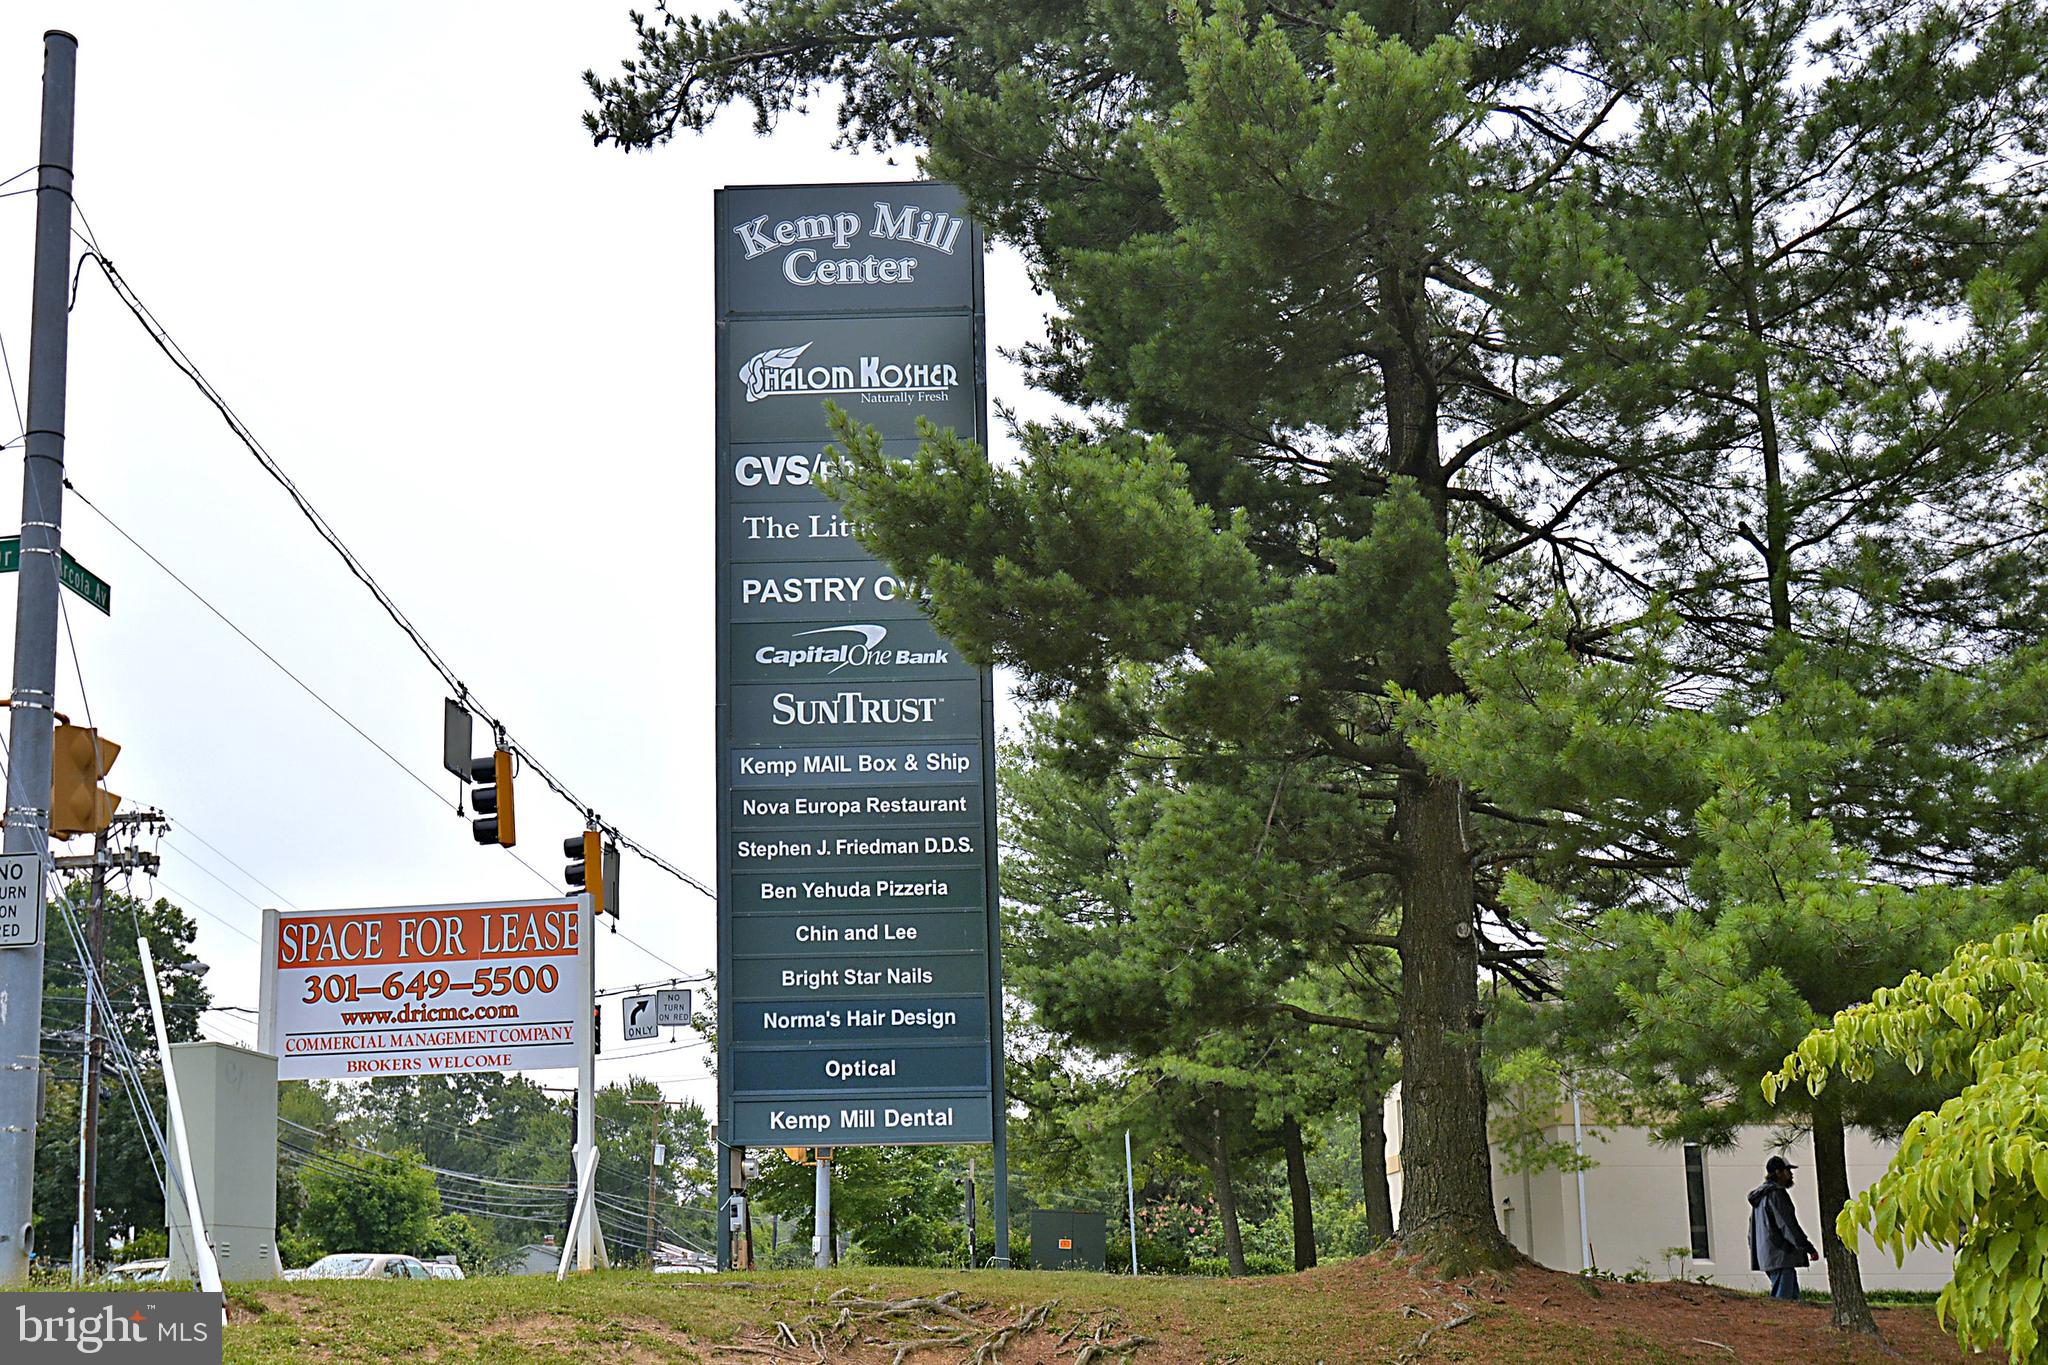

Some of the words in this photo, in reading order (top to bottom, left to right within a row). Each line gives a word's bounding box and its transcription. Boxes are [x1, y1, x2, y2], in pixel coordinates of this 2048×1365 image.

[733, 212, 861, 260] Kemp
[870, 201, 963, 255] Mill
[782, 248, 917, 286] Center
[860, 356, 958, 388] KOSHER
[861, 392, 914, 405] Naturally
[918, 391, 949, 402] Fresh
[742, 516, 800, 539] The
[60, 562, 90, 596] rcola
[95, 583, 107, 606] Av
[743, 576, 866, 603] PASTRY
[896, 650, 948, 665] Bank
[740, 757, 797, 777] Kemp
[803, 755, 852, 773] MAIL
[858, 754, 897, 772] Box
[904, 753, 919, 771] &
[926, 753, 970, 772] Ship
[743, 799, 789, 815] Nova
[795, 798, 861, 817] Europa
[866, 796, 967, 813] Restaurant
[737, 841, 812, 860] Stephen
[816, 840, 831, 856] J.
[836, 838, 919, 855] Friedman
[924, 837, 974, 853] D.D.S.
[0, 886, 26, 899] URN
[761, 883, 797, 899] Ben
[802, 882, 871, 898] Yehuda
[876, 880, 948, 896] Pizzeria
[0, 924, 20, 937] ED
[281, 920, 383, 964] SPACE
[398, 917, 466, 959] FOR
[480, 909, 579, 955] LEASE
[795, 925, 838, 942] Chin
[844, 925, 878, 940] and
[884, 924, 918, 940] Lee
[302, 964, 559, 1004] 301-649-5500
[782, 969, 839, 990] Bright
[843, 968, 882, 985] Star
[887, 967, 933, 984] Nails
[341, 1002, 519, 1026] www.dricmc.com
[763, 1011, 841, 1029] Norma's
[847, 1010, 886, 1026] Hair
[891, 1009, 957, 1029] Design
[286, 1032, 386, 1052] COMMERCIAL
[390, 1029, 498, 1048] MANAGEMENT
[499, 1026, 573, 1044] COMPANY
[629, 1026, 653, 1037] ONLY
[347, 1056, 422, 1073] BROKERS
[429, 1054, 512, 1069] WELCOME
[825, 1059, 896, 1080] Optical
[770, 1111, 831, 1132] Kemp
[840, 1109, 875, 1128] Mill
[884, 1107, 953, 1128] Dental
